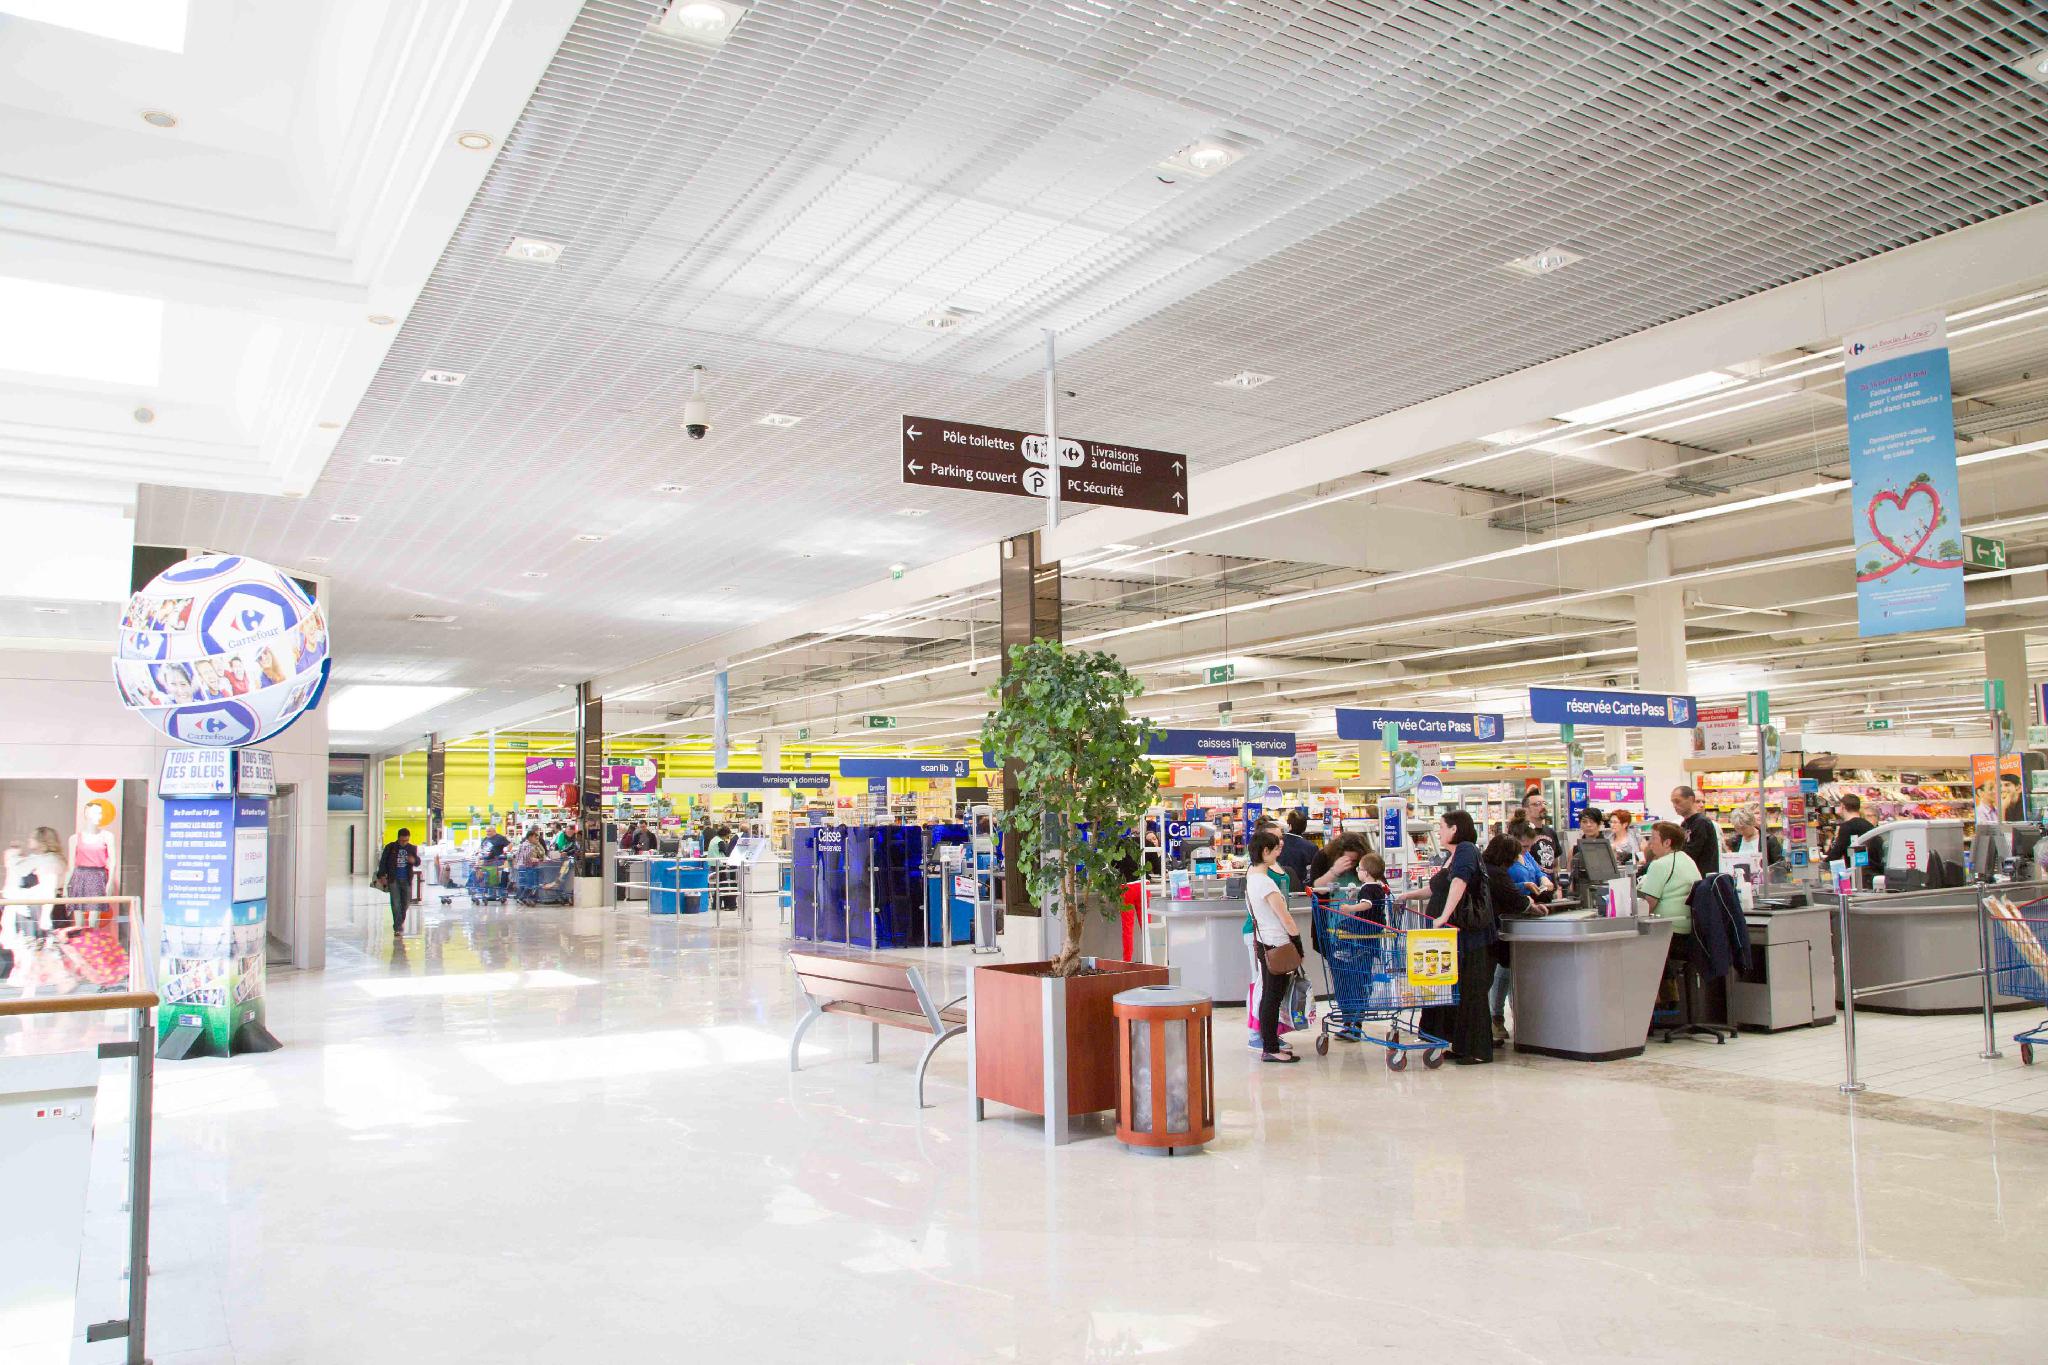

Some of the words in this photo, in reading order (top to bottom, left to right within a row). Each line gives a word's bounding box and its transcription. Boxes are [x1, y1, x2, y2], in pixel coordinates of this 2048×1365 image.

[943, 430, 967, 445] Pôle
[969, 434, 1015, 451] toilettes
[1091, 445, 1139, 461] Livraisons
[1091, 457, 1098, 468] à
[1100, 458, 1142, 474] domicile
[930, 463, 974, 482] Parking
[975, 471, 1018, 484] couvert
[1068, 480, 1081, 492] PC
[1083, 481, 1124, 497] Sécurité
[228, 627, 280, 649] Carrefour
[1566, 697, 1611, 714] réservée
[1612, 700, 1641, 715] Carte
[1641, 702, 1665, 717] Pass
[1418, 718, 1447, 732] Carte
[1448, 720, 1472, 733] Pass
[187, 731, 235, 742] Carrefour
[1197, 737, 1231, 748] caisses
[170, 751, 195, 764] TOUS
[199, 750, 225, 763] FANS
[241, 751, 257, 764] TOUS
[166, 766, 186, 779] DES
[190, 765, 225, 778] BLEUS
[241, 765, 254, 778] DES
[255, 766, 273, 780] BLEUS
[939, 763, 949, 772] lib
[762, 775, 792, 784] livraison
[798, 776, 829, 784] domicile
[818, 828, 842, 843] Caisse
[1168, 821, 1191, 837] Cai
[1169, 838, 1182, 847] libr
